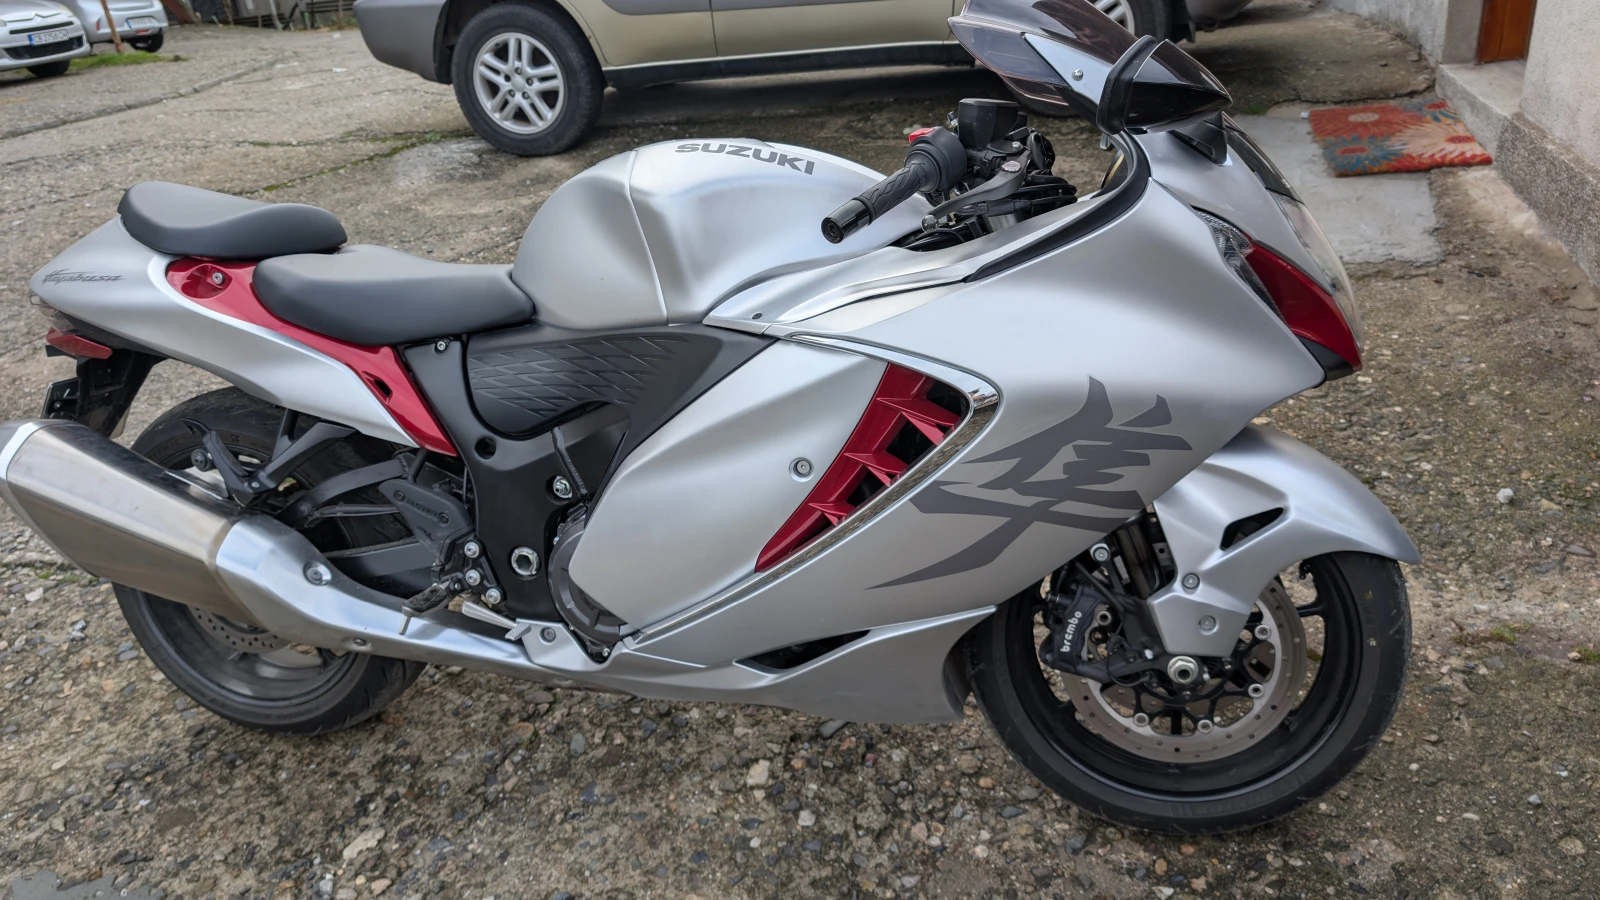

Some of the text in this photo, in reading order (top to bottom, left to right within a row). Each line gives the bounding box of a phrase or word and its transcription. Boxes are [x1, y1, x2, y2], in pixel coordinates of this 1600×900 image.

[675, 143, 815, 175] SUZUKI
[42, 268, 125, 286] Hayabusa
[1060, 611, 1082, 652] brembo
